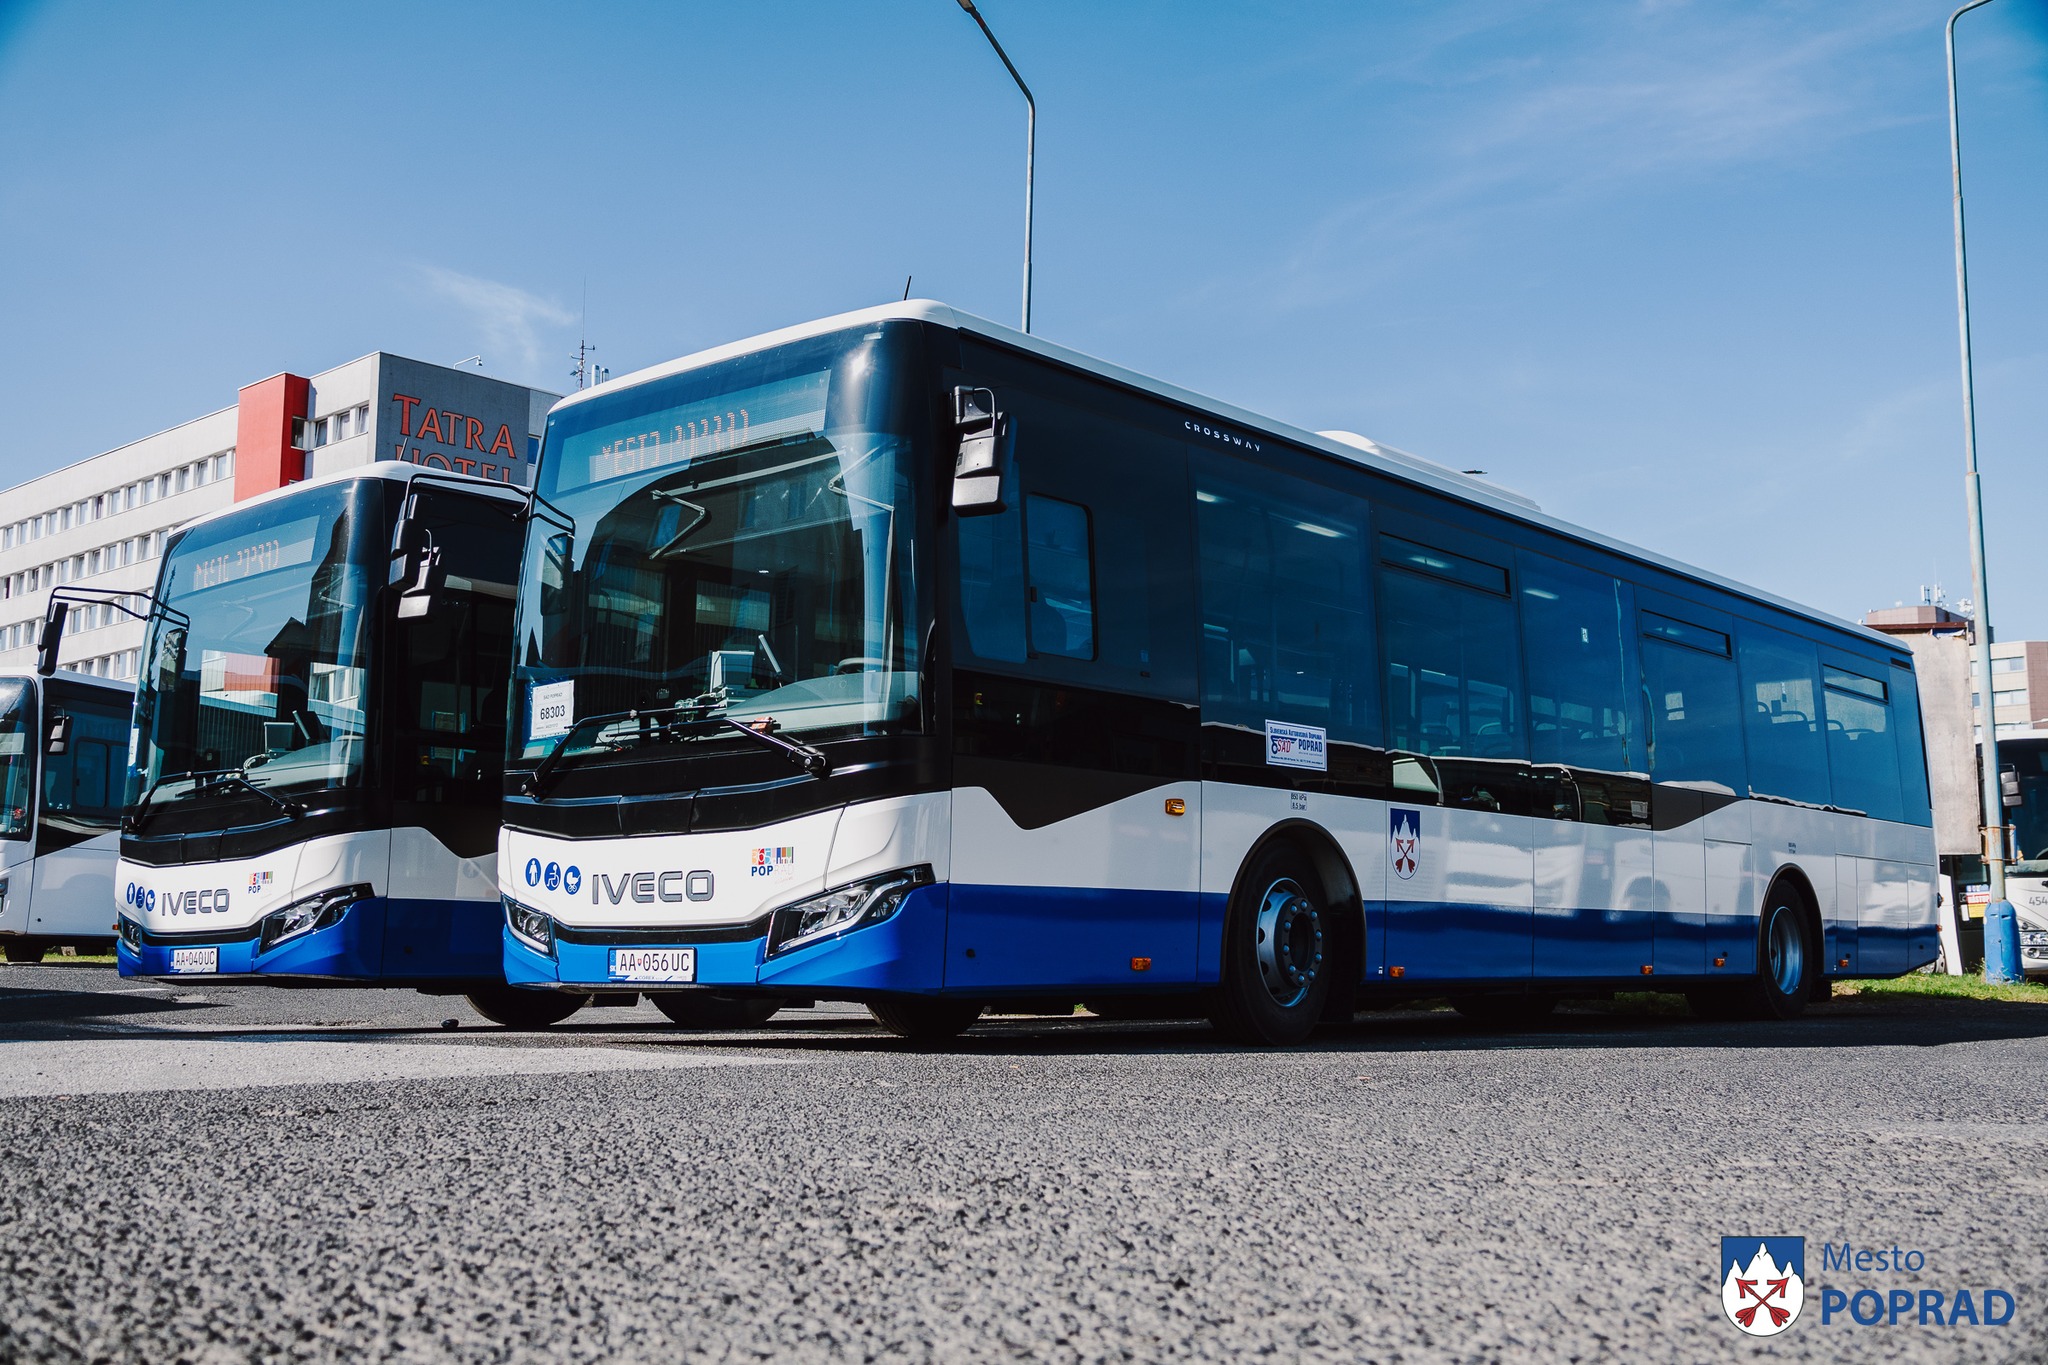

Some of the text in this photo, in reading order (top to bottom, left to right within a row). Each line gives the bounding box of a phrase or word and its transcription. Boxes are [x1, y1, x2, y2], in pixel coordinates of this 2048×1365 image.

[392, 393, 517, 459] TATRA
[1184, 421, 1260, 452] CROSSWAY
[540, 704, 565, 720] 68303
[1298, 739, 1322, 752] POPRAD
[162, 888, 230, 916] IVECO
[592, 870, 714, 905] IVECO
